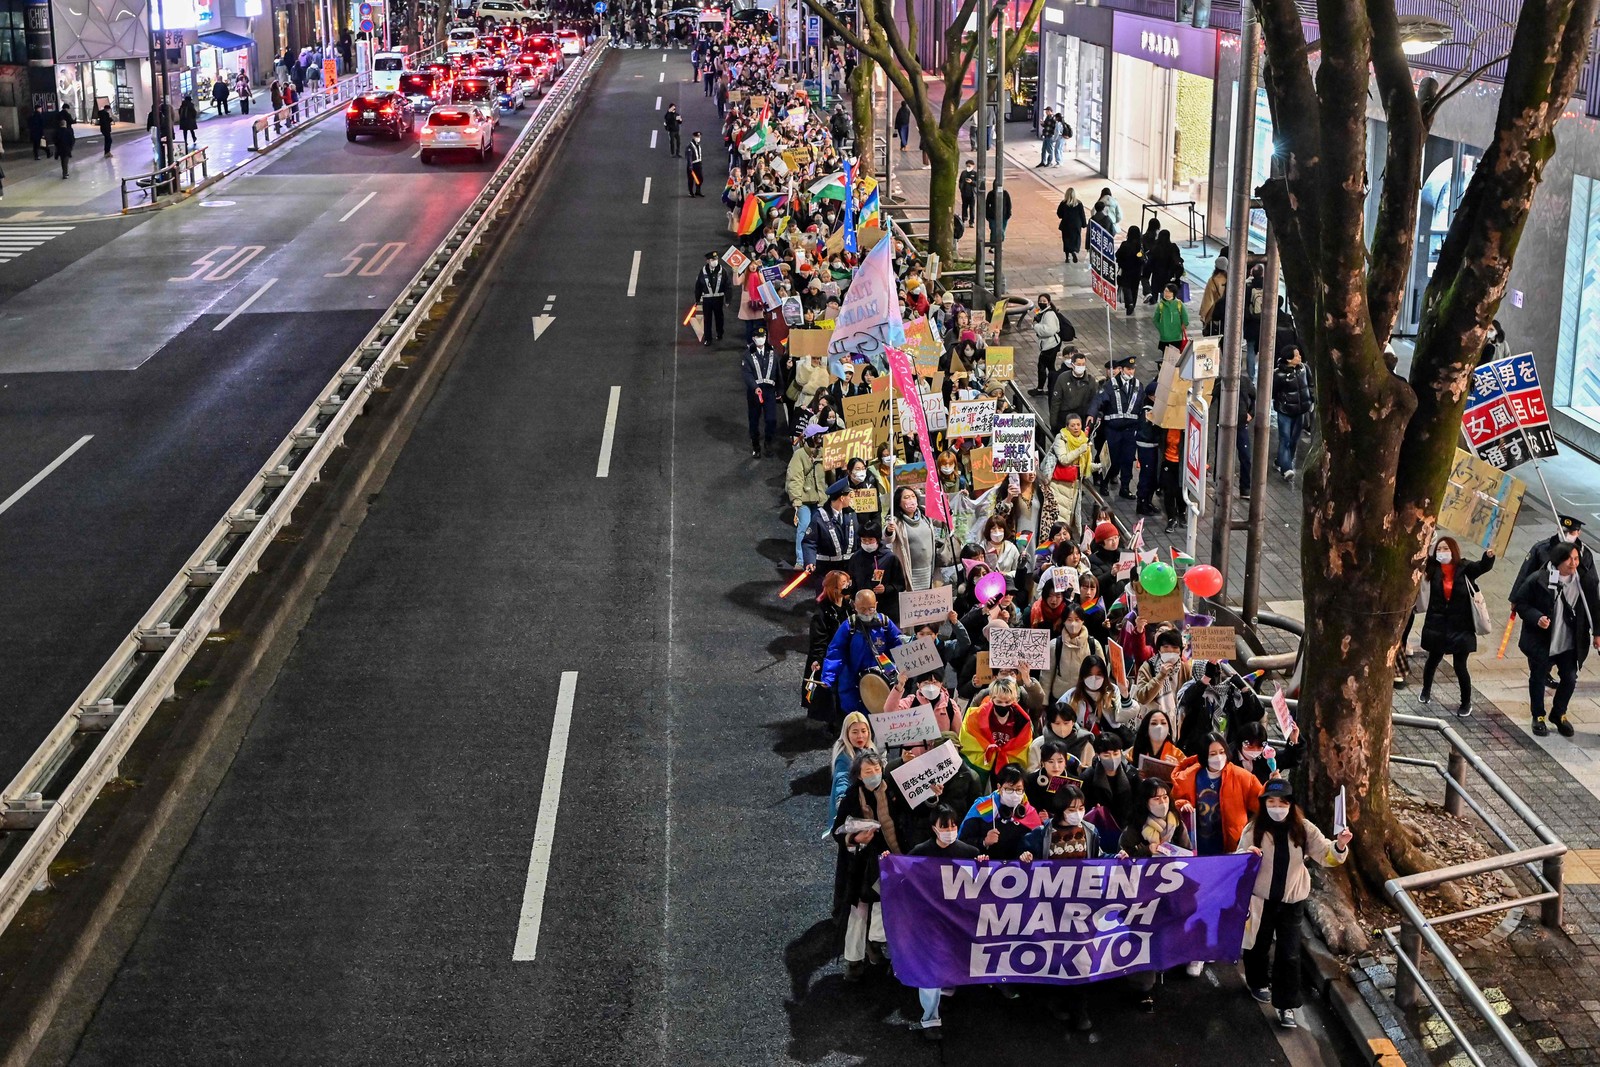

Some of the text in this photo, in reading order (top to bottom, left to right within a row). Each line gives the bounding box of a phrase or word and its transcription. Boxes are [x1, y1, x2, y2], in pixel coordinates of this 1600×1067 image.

[810, 18, 818, 29] P
[168, 246, 266, 282] 50
[323, 242, 407, 278] 50
[1467, 361, 1536, 400] 装男を
[847, 402, 875, 417] SEE
[993, 415, 1035, 428] Revolution
[1467, 397, 1544, 440] 女風呂に
[902, 758, 953, 791] 原告女性、家族
[941, 861, 1189, 899] WOMEN'S
[976, 898, 1160, 937] MARCH
[982, 932, 1142, 977] TOKYO
